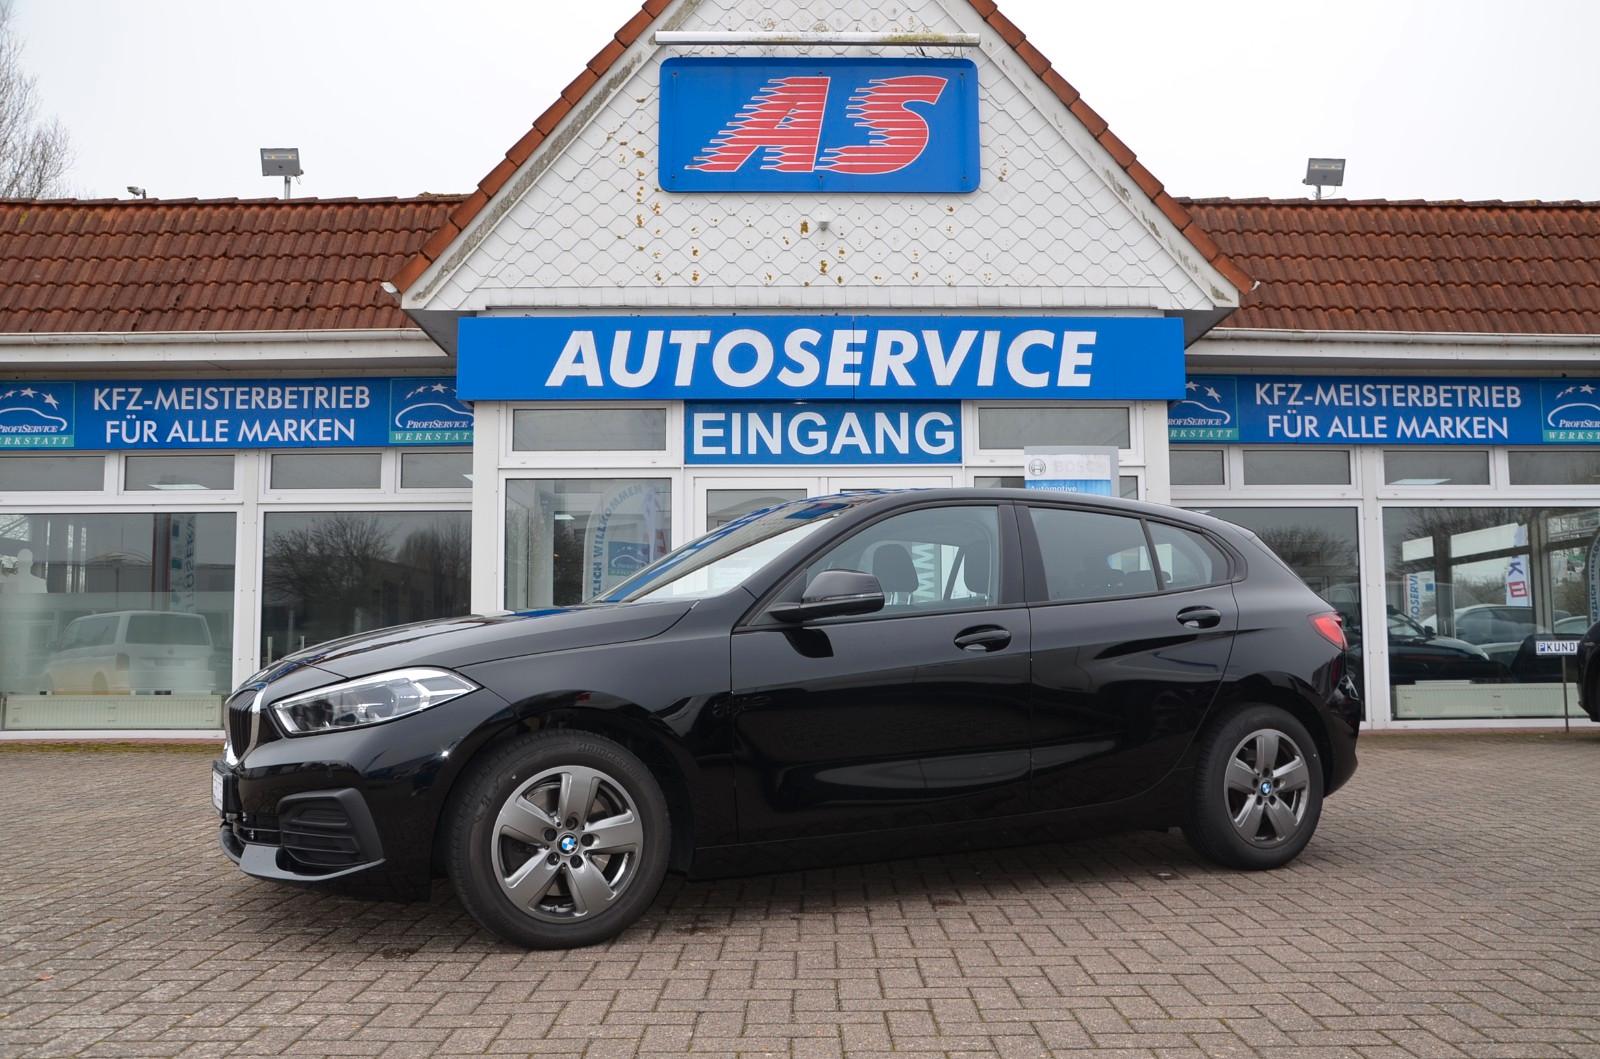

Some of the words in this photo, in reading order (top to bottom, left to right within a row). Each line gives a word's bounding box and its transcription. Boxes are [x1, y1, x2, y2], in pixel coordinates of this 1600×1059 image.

[684, 75, 949, 175] AS
[545, 328, 1097, 389] AUTOSERVICE
[94, 386, 370, 411] KFZ-MEISTERBETRIEB
[1256, 383, 1522, 408] KFZ-MEISTERBETRIEB
[106, 415, 158, 443] FÜR
[166, 419, 229, 442] ALLE
[237, 418, 355, 441] MARKEN
[693, 411, 955, 456] EINGANG
[1268, 410, 1320, 438] FÜR
[1327, 416, 1387, 438] ALLE
[1396, 416, 1508, 439] MARKEN
[0, 436, 69, 446] RKSTATT
[1547, 642, 1579, 652] KUND
